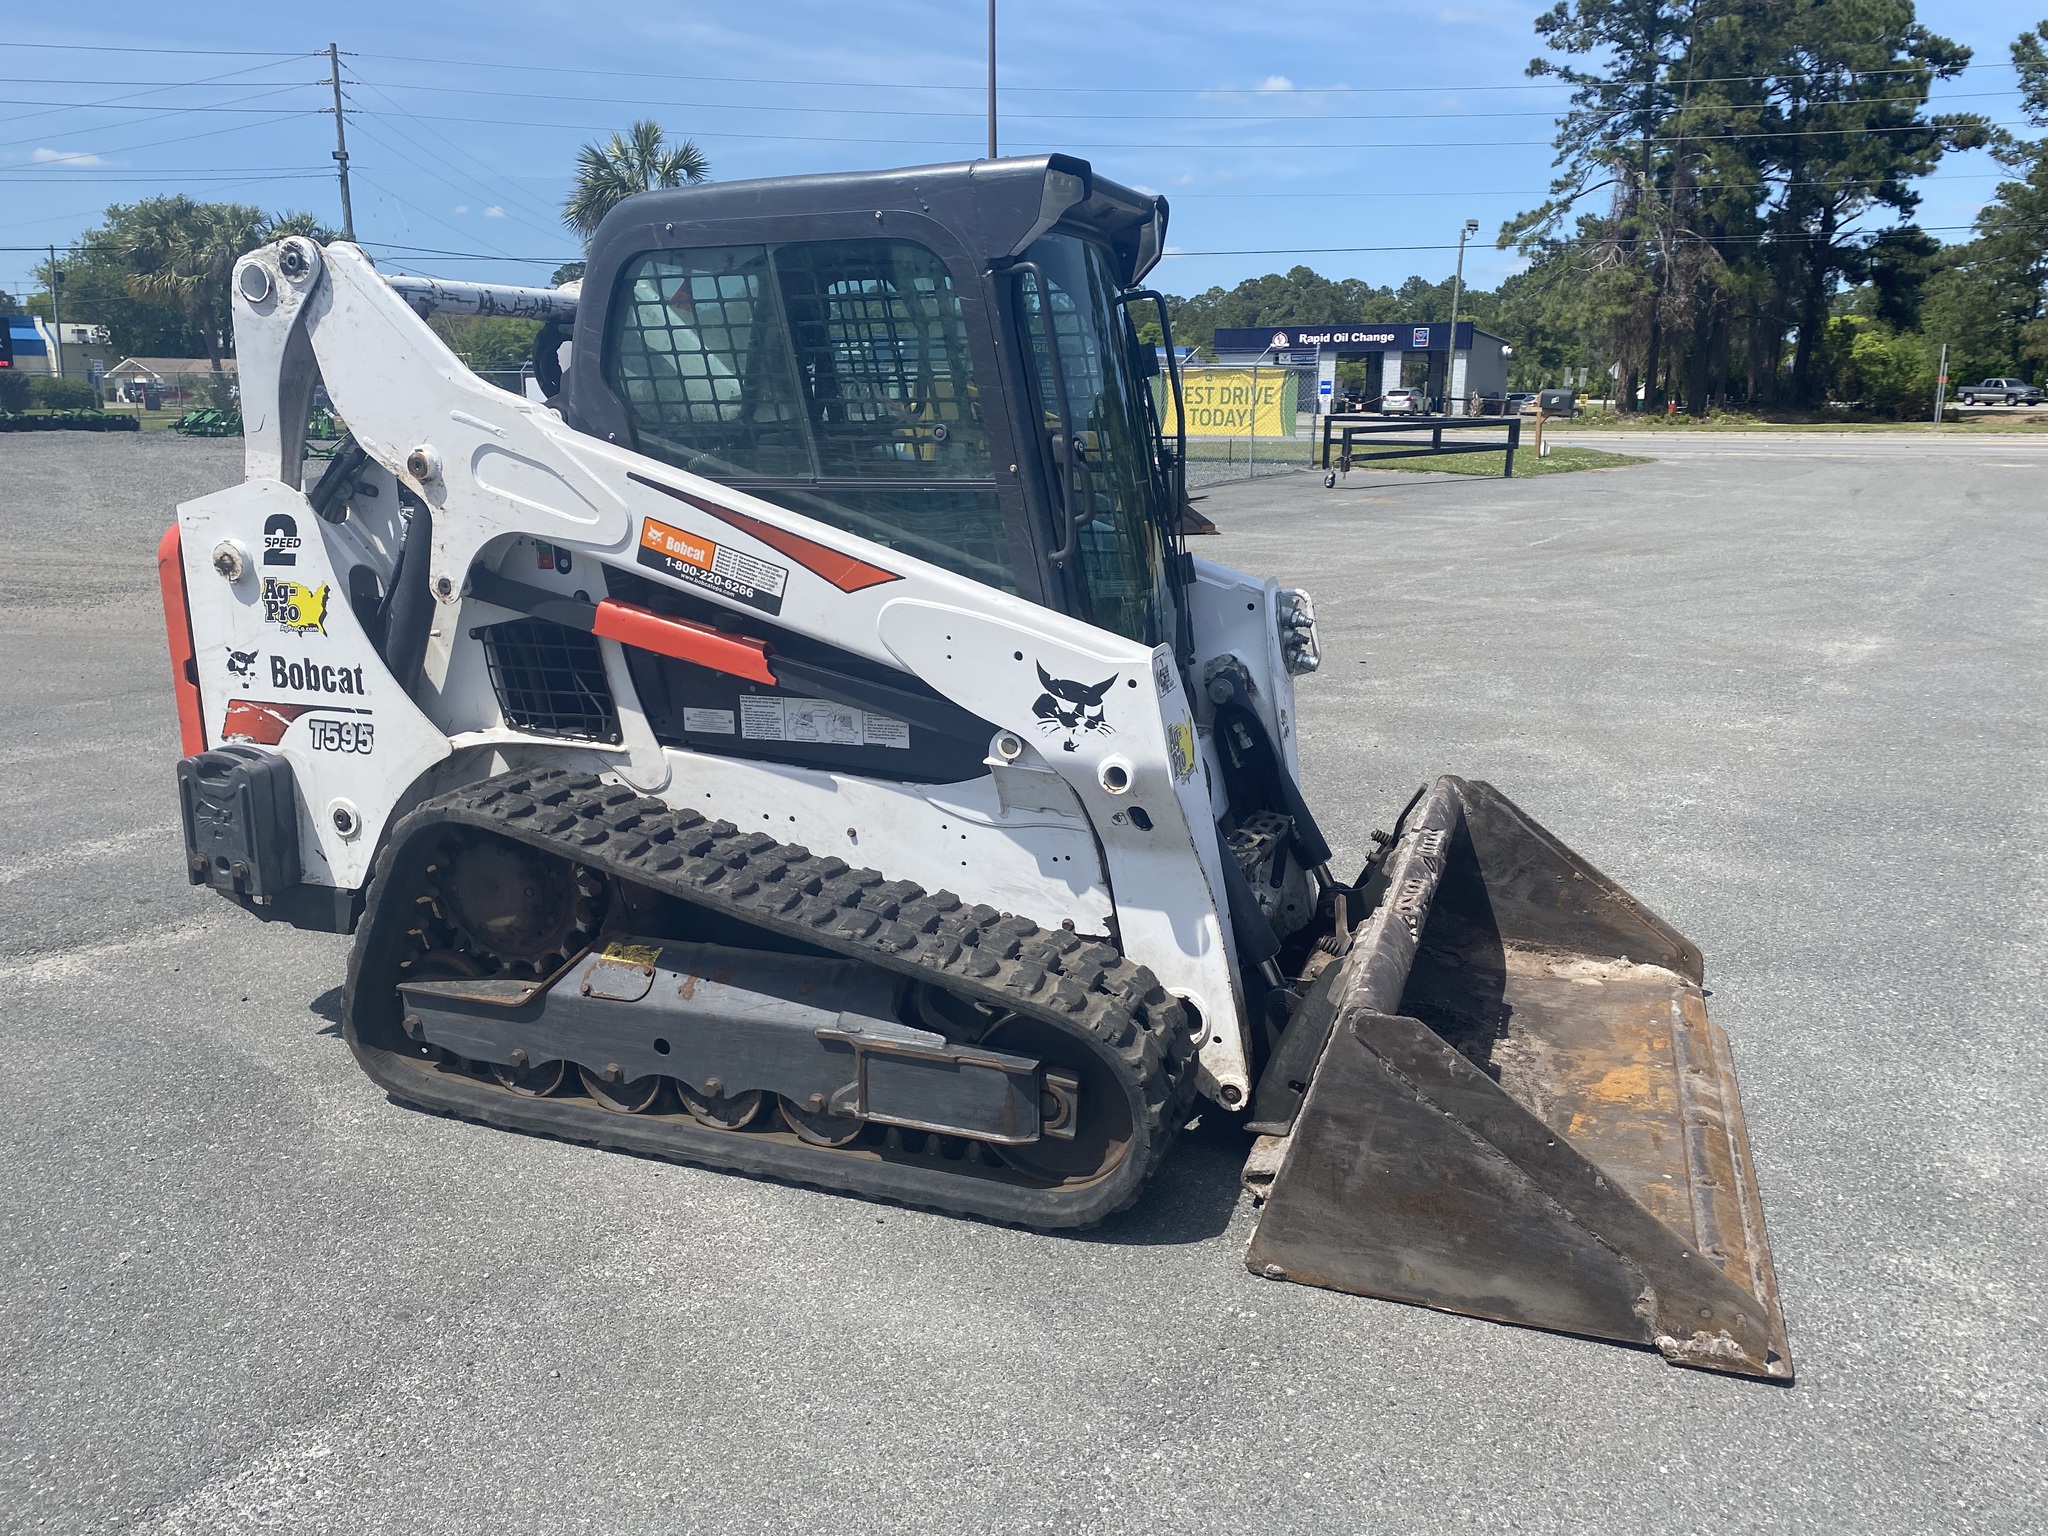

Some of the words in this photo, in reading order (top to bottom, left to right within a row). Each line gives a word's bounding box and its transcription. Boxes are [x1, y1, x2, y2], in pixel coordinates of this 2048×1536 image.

[1300, 333, 1330, 344] Rapid
[1334, 332, 1348, 342] Oil
[1352, 332, 1395, 344] Change
[1182, 386, 1215, 404] EST
[1220, 386, 1274, 404] DRIVE
[263, 514, 298, 566] 2
[264, 537, 302, 548] SPEED
[666, 536, 706, 562] Bobcat
[665, 557, 754, 598] 1-800-220-6266
[263, 578, 298, 604] Ag-
[265, 600, 300, 622] Pro
[280, 625, 319, 633] AgProCo.com
[270, 655, 364, 695] Bobcat
[309, 719, 374, 755] T595
